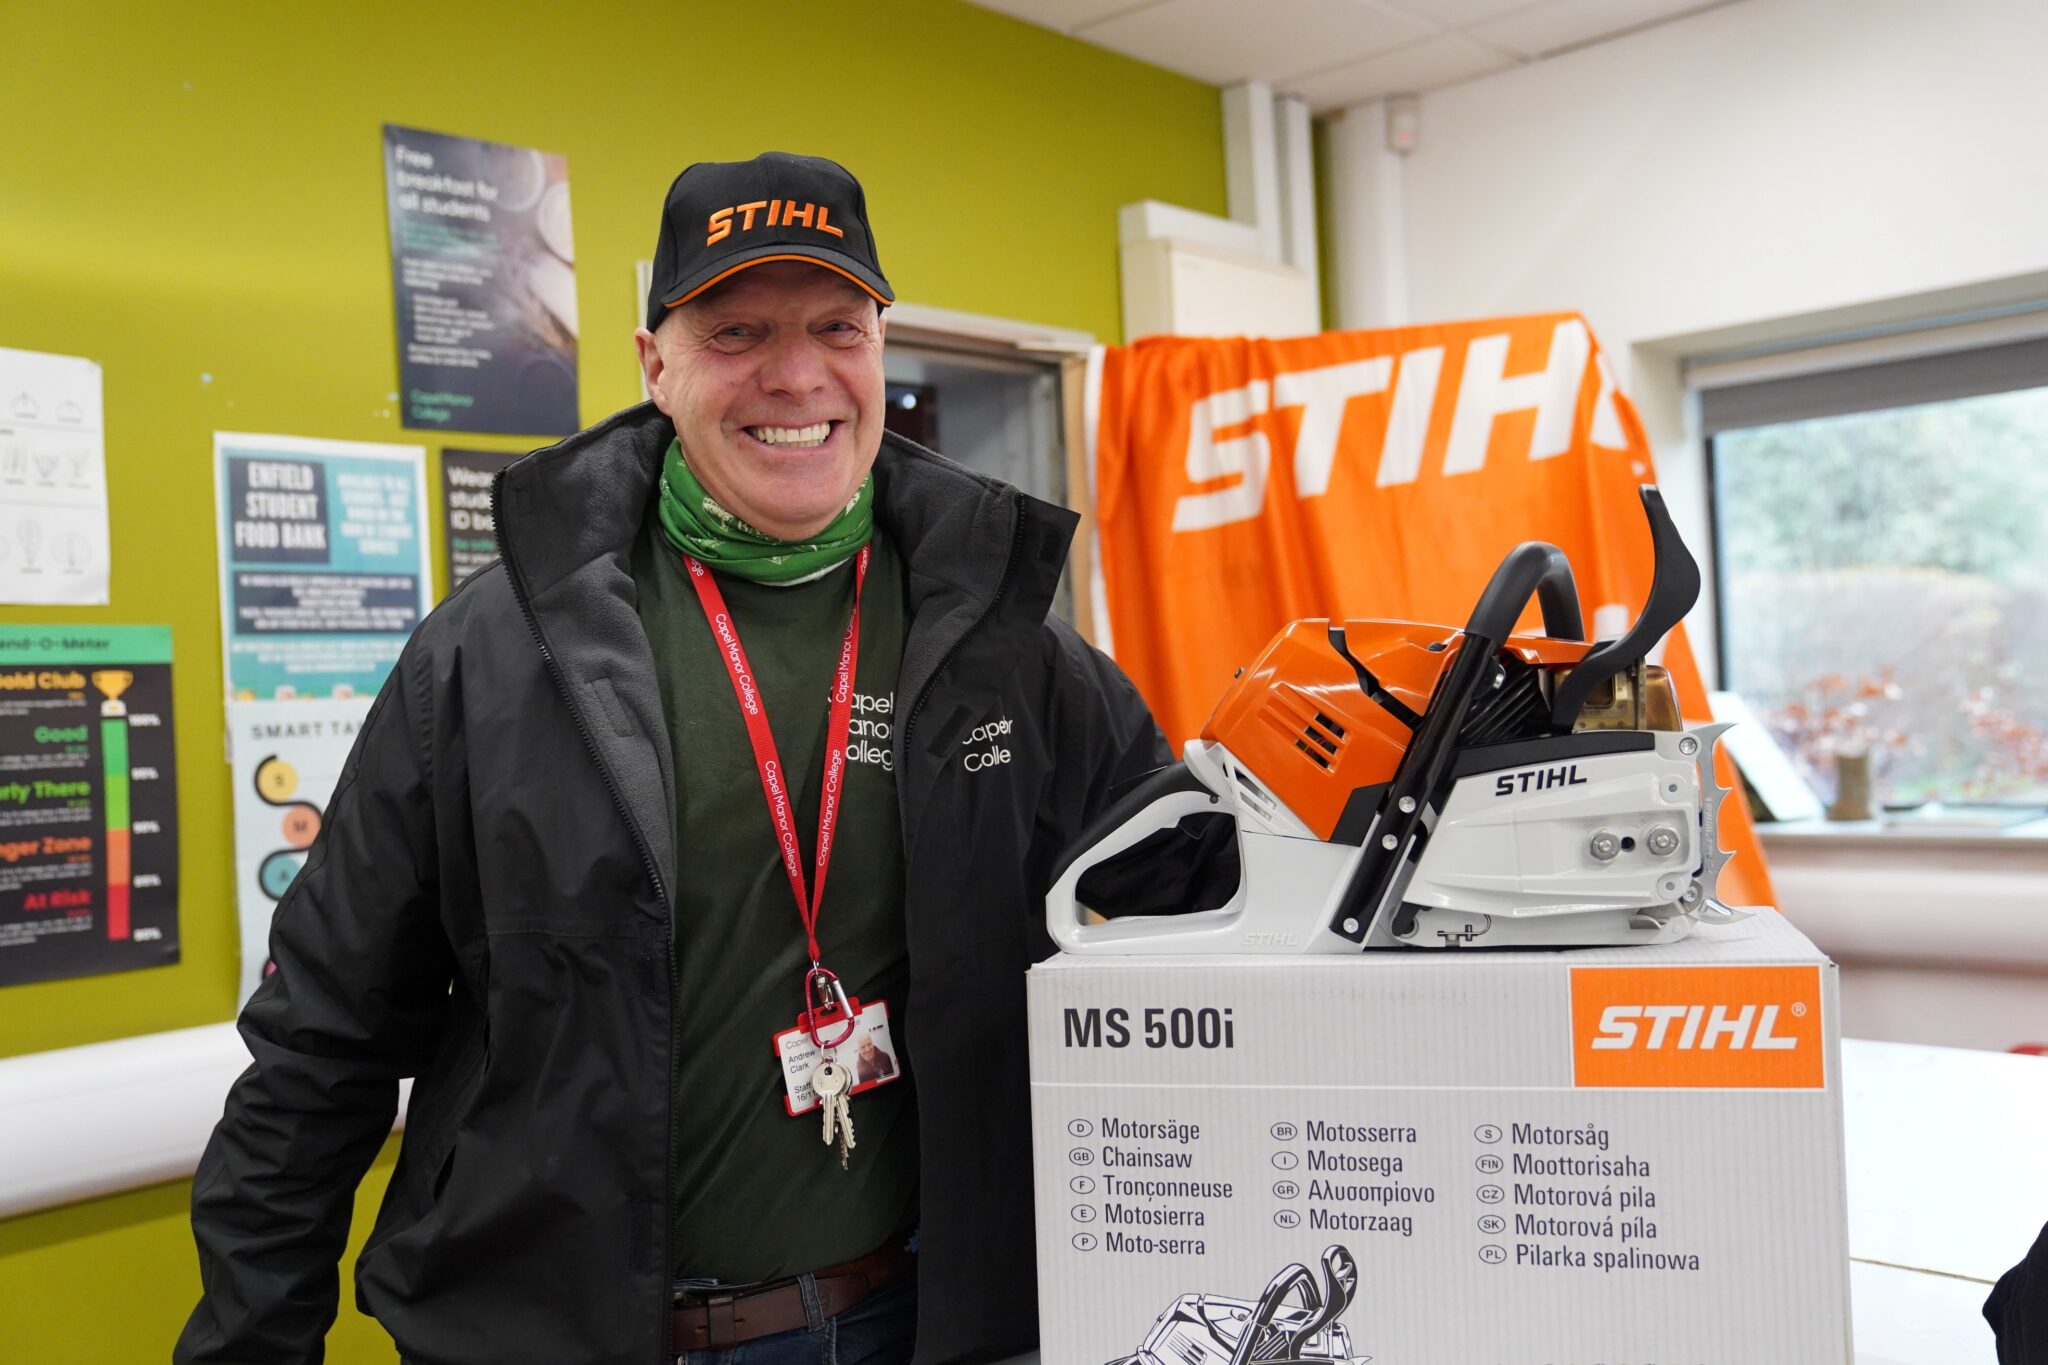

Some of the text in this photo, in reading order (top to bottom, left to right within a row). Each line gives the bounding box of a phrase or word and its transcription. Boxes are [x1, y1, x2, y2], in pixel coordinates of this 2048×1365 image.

[396, 145, 433, 169] Free
[422, 196, 491, 222] students
[706, 199, 844, 247] STIHL
[248, 462, 314, 491] ENFIELD
[246, 492, 318, 520] STUDENT
[234, 521, 279, 549] FOOD
[281, 523, 327, 550] BANK
[715, 613, 759, 715] Capel Manor College
[838, 640, 851, 672] Manor
[0, 671, 36, 690] old
[835, 672, 850, 703] Capel
[850, 691, 894, 715] apel
[251, 721, 322, 741] SMART
[848, 718, 892, 740] ano
[846, 740, 894, 771] olleg
[964, 745, 1012, 772] Colle
[1494, 762, 1589, 798] STIHL
[765, 760, 797, 877] Capel Manor College
[818, 749, 842, 867] Capel Manor College
[1241, 931, 1299, 947] STIHL
[1063, 1007, 1234, 1049] MS 500i
[788, 1049, 816, 1064] Andrew
[790, 1062, 810, 1074] Clark
[1101, 1117, 1200, 1144] Motorsäge
[1306, 1120, 1417, 1143] Motosserra
[1512, 1123, 1609, 1150] Motorsåg
[1102, 1146, 1193, 1168] Chainsaw
[1307, 1150, 1403, 1177] Motosega
[1513, 1153, 1650, 1177] Moottorisaha
[1102, 1175, 1233, 1202] Tronçonneuse
[1514, 1184, 1612, 1207] Motorová
[1620, 1185, 1656, 1212] pila
[1105, 1203, 1205, 1227] Motosierra
[1309, 1209, 1412, 1236] Motorzaag
[1515, 1214, 1613, 1238] Motorová
[1621, 1216, 1657, 1242] píla
[1106, 1231, 1205, 1255] Moto-serra
[1516, 1244, 1586, 1267] Pilarka
[1593, 1246, 1700, 1273] spalinowa
